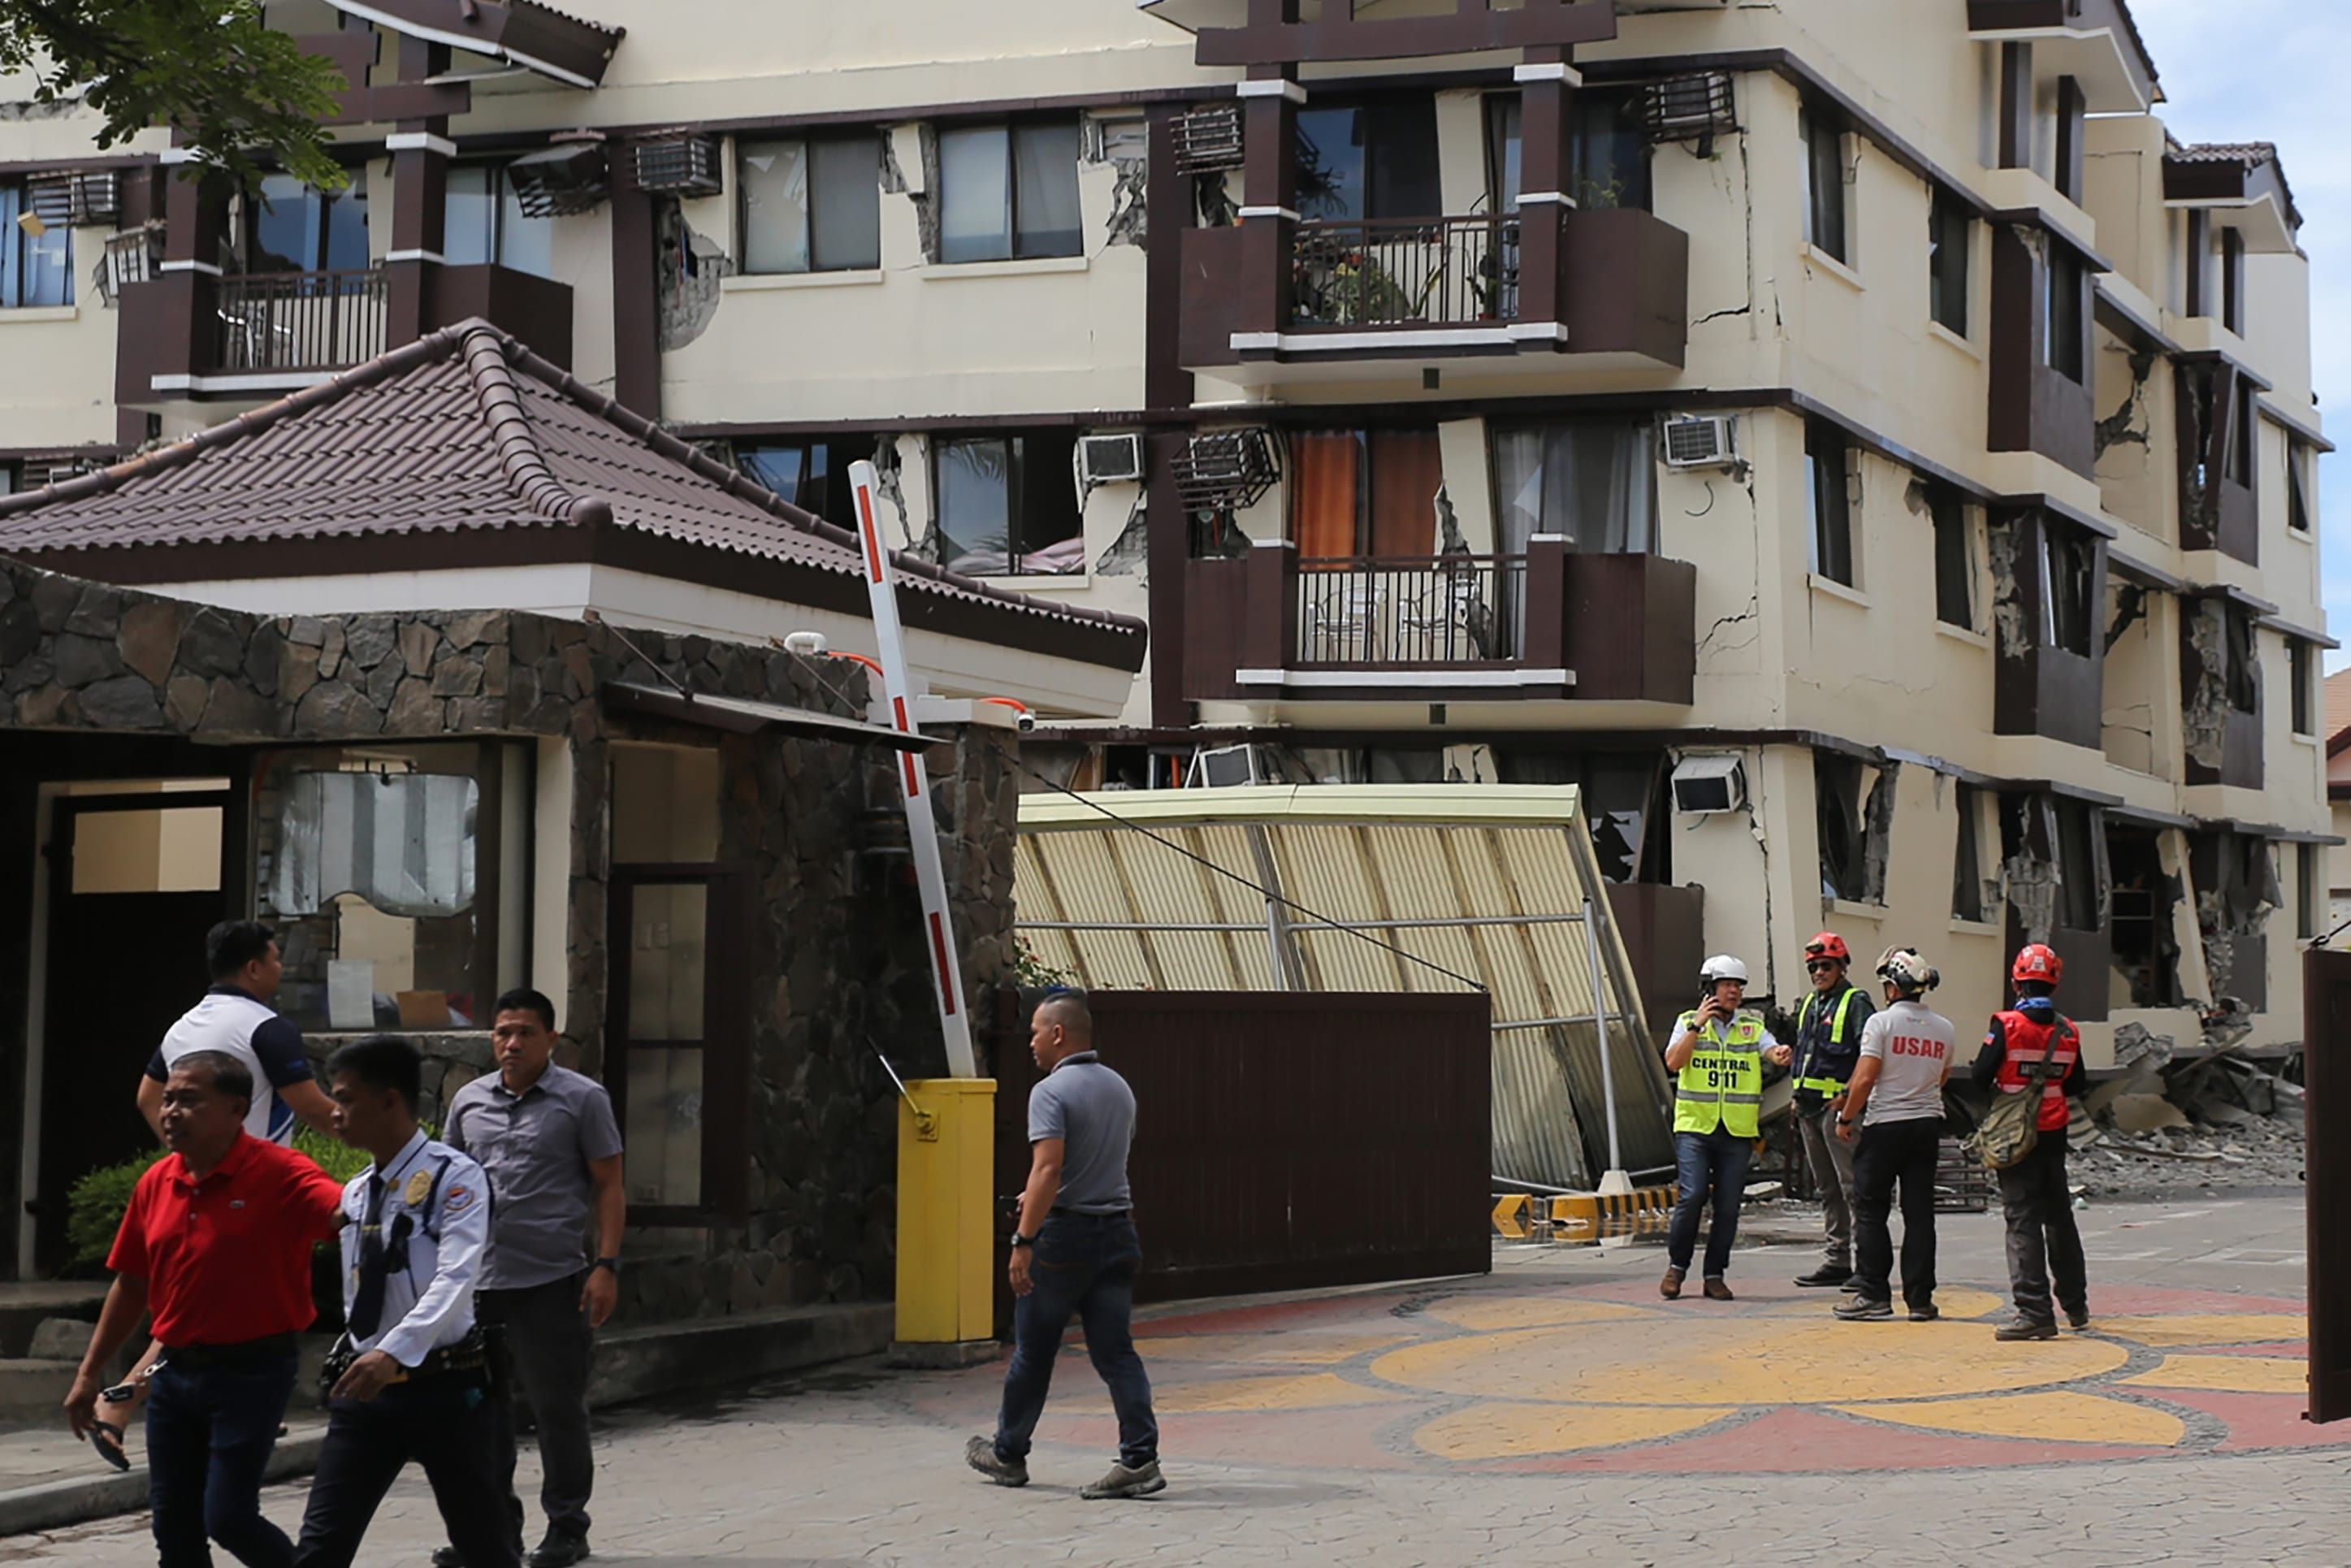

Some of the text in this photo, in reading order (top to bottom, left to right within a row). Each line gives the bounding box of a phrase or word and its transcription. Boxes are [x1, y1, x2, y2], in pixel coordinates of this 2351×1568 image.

[1891, 1035, 1945, 1060] USAR
[1691, 1057, 1751, 1072] CENTRAL
[1708, 1071, 1737, 1089] 911
